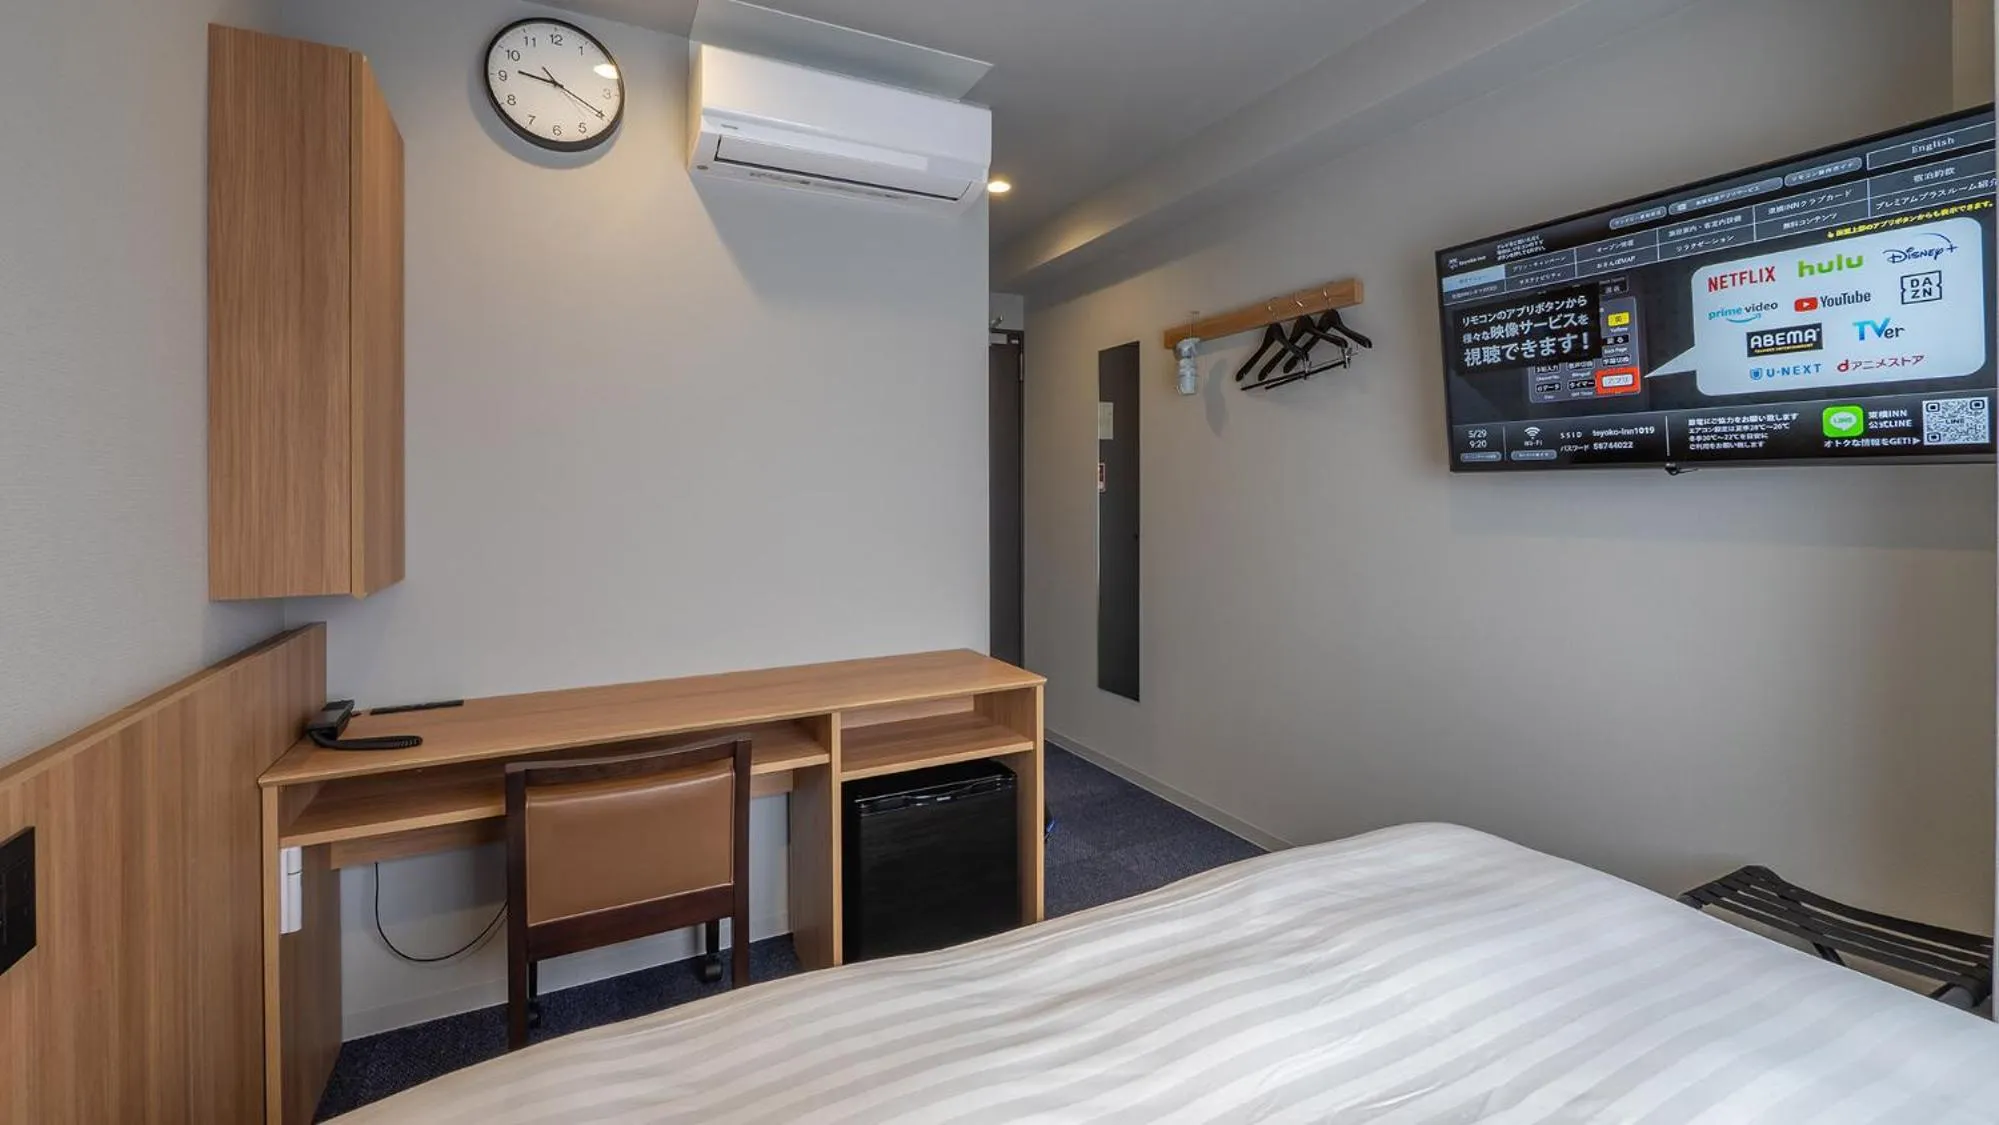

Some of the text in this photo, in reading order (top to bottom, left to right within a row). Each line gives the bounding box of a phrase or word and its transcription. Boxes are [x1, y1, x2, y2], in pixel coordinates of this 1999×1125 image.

[524, 36, 537, 48] 11
[550, 33, 563, 46] 12
[506, 49, 521, 62] 10
[578, 46, 584, 56] 1
[498, 70, 507, 82] 9
[602, 88, 611, 99] 3
[507, 94, 517, 106] 8
[528, 114, 536, 125] 7
[552, 124, 562, 136] 6
[578, 122, 587, 134] 5
[1911, 137, 1955, 154] English
[1798, 253, 1864, 278] hulu
[1708, 266, 1776, 293] NETFLIX
[1910, 276, 1933, 289] DA
[1911, 287, 1933, 299] ZN
[1820, 290, 1872, 309] YouTube
[1462, 294, 1588, 328] リモコンのアプリボタンから
[1708, 300, 1779, 321] prime video
[1462, 312, 1589, 345] 様々な映像サービスを
[1853, 317, 1905, 341] TVer
[1750, 328, 1817, 349] ABEMA
[1837, 354, 1925, 373] dアニメストア
[1868, 409, 1908, 420] 東横INN
[1868, 419, 1913, 429] 公式LINE
[1468, 429, 1487, 439] 5/29
[1469, 440, 1487, 449] 9:20
